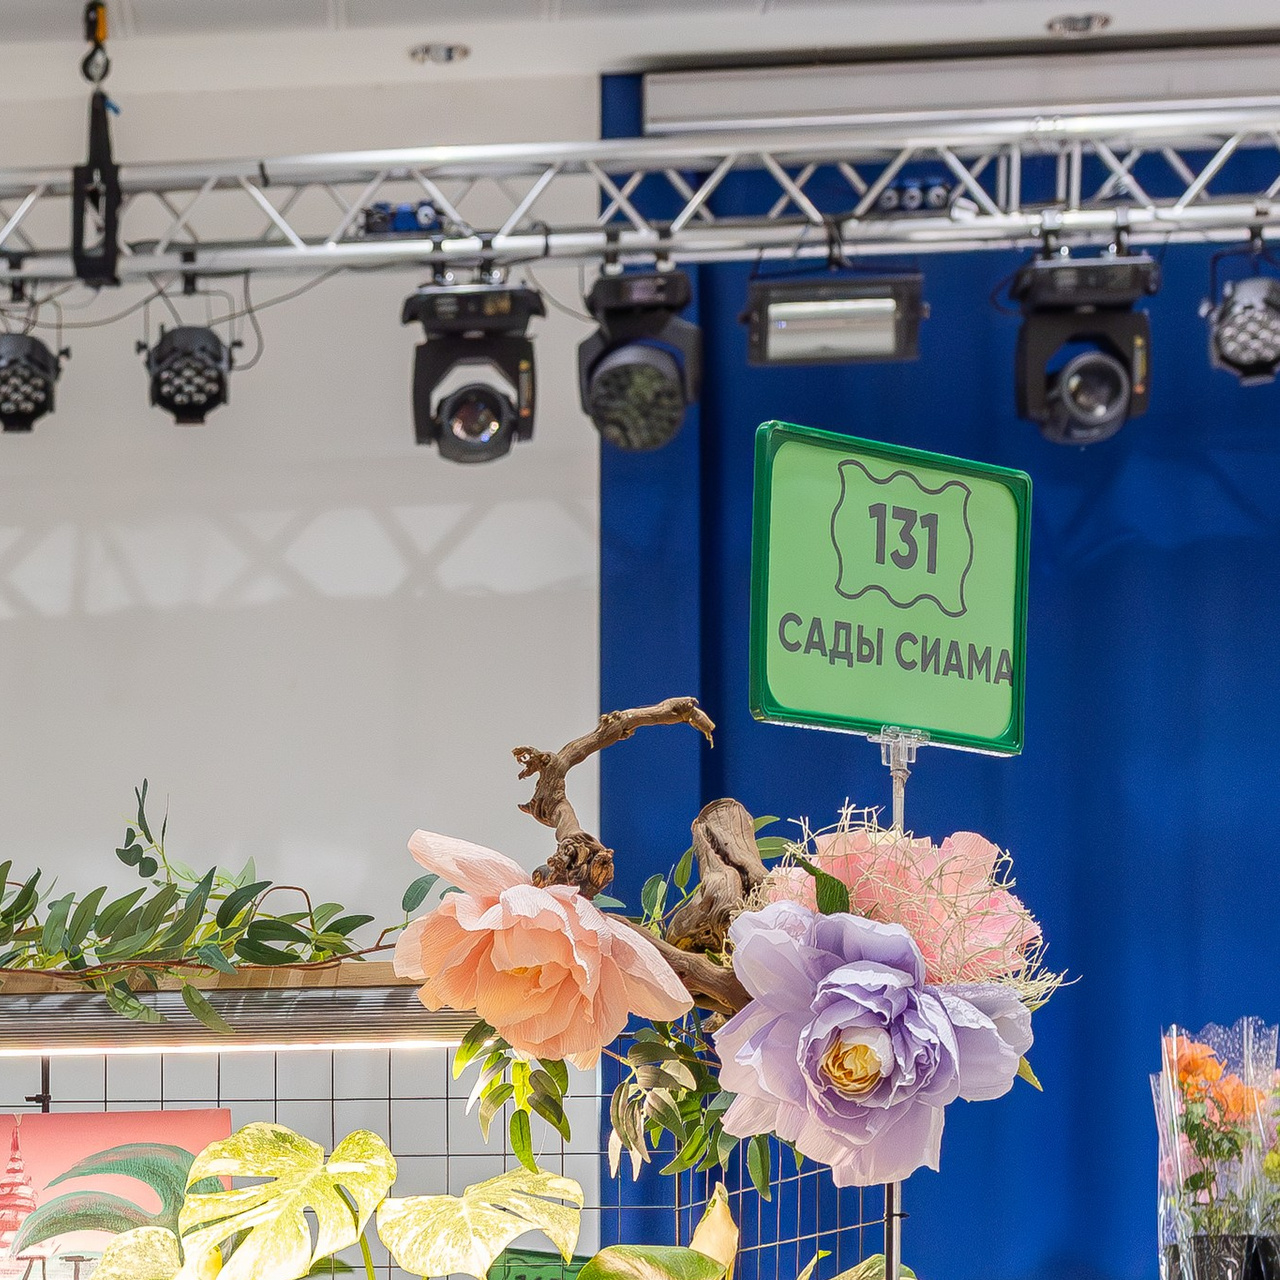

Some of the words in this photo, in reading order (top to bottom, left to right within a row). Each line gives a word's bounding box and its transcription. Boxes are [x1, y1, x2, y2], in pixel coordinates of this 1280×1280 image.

[868, 503, 939, 574] 131
[778, 612, 884, 668] САДЫ
[895, 632, 1014, 687] СИАМА
